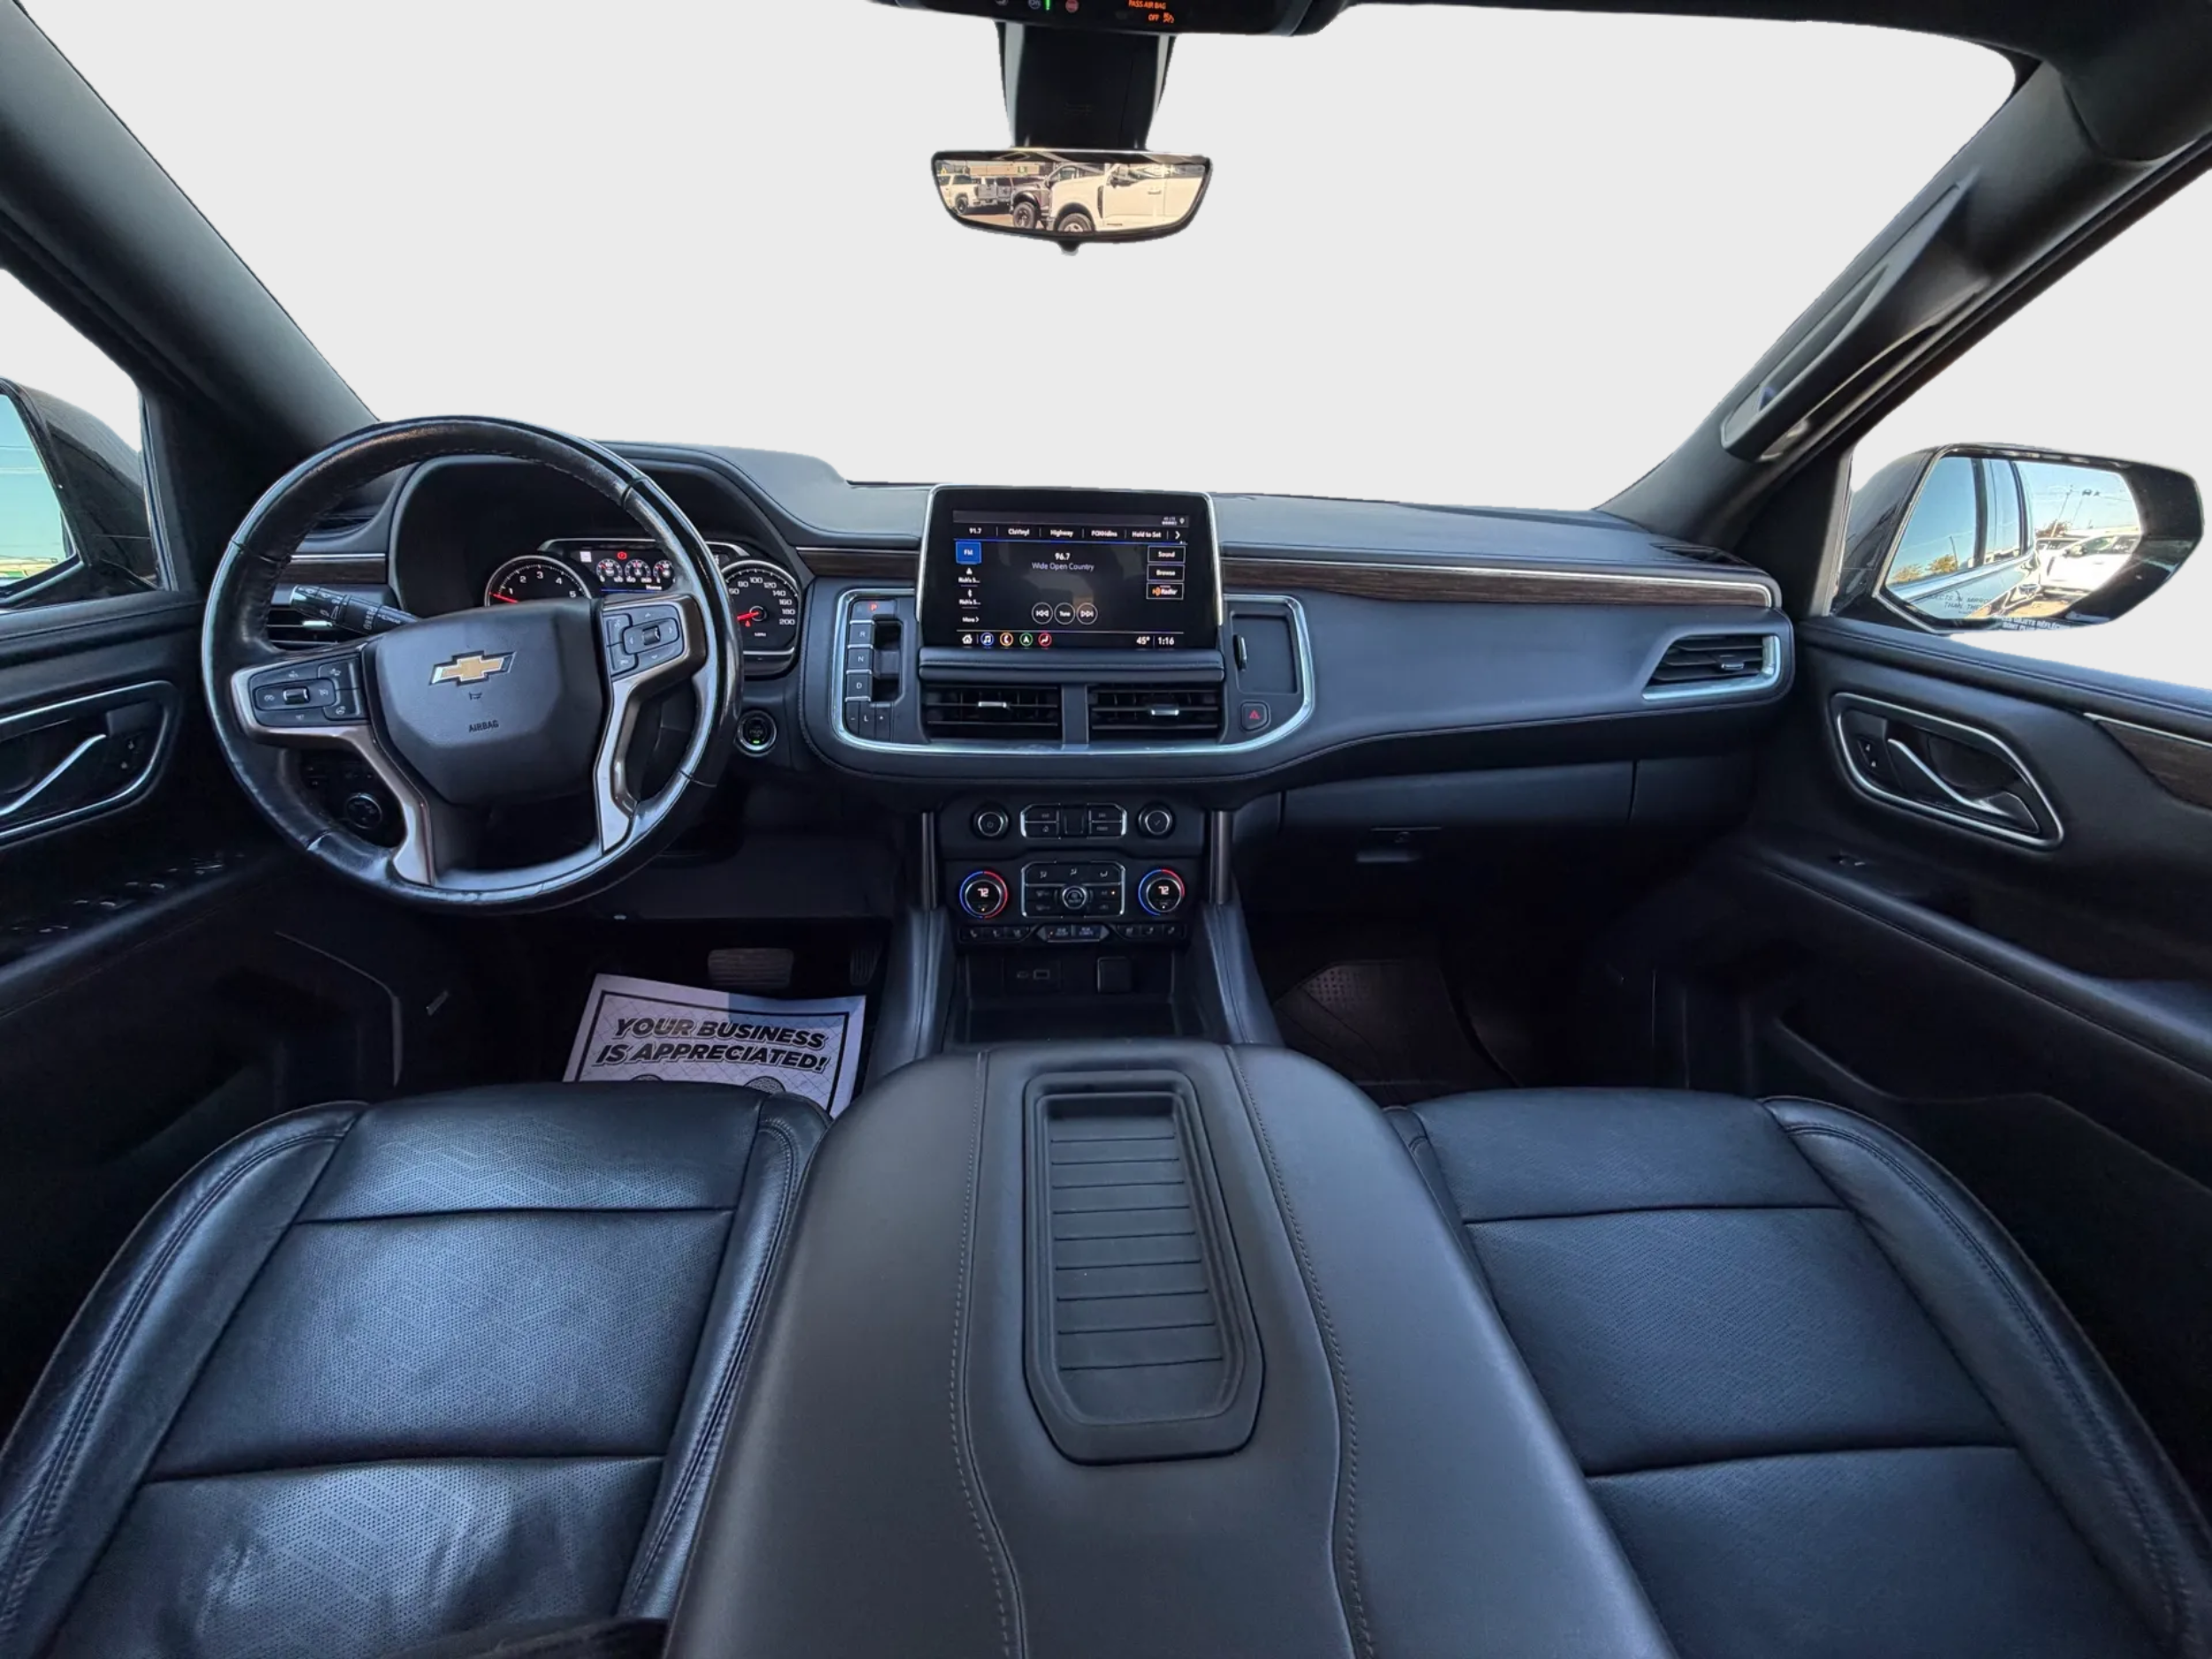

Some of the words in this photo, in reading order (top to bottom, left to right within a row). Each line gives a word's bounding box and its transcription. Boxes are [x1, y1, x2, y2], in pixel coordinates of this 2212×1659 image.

[1050, 529, 1074, 538] Highway
[1049, 563, 1067, 572] Open
[1069, 563, 1094, 572] Country
[1157, 637, 1175, 646] 1:16
[469, 719, 499, 733] AIRBAG
[977, 887, 989, 897] 72
[1157, 885, 1170, 895] 72
[614, 1018, 696, 1039] YOUR
[696, 1021, 827, 1048] BUSINESS
[595, 1044, 629, 1064] IS
[632, 1043, 831, 1071] APPRECIATED!
